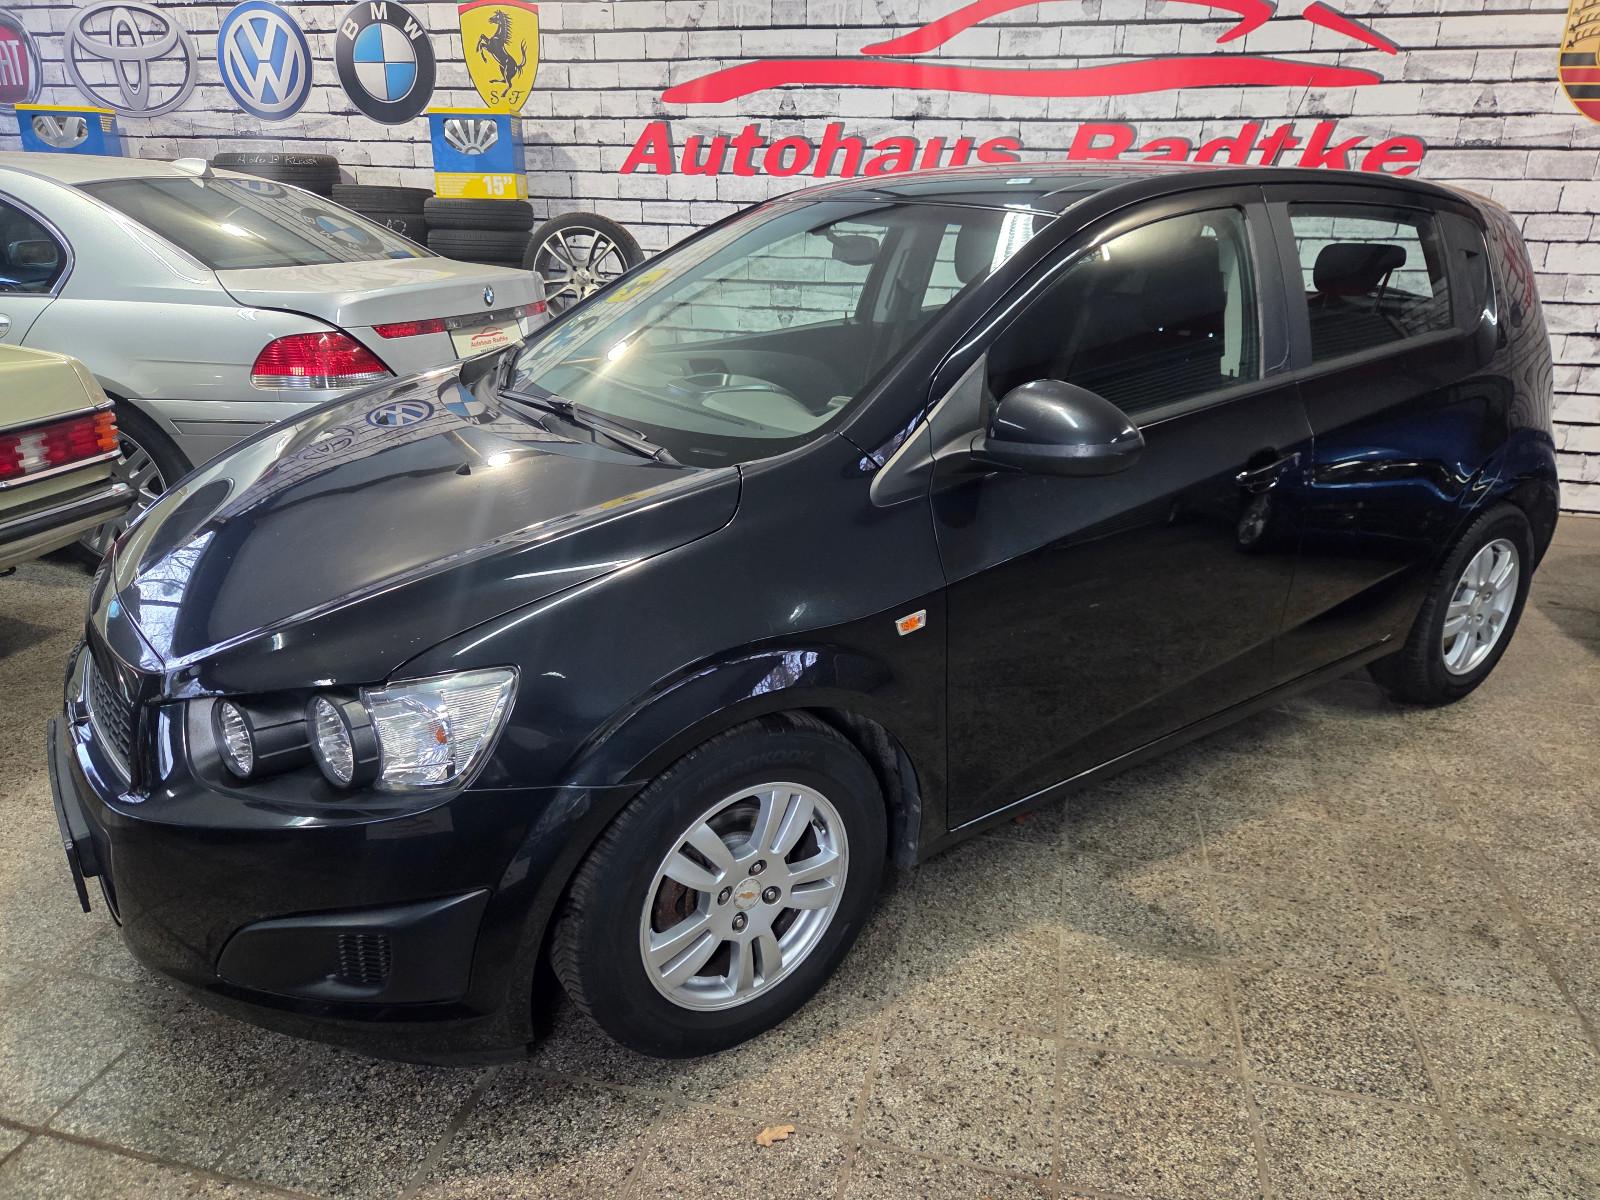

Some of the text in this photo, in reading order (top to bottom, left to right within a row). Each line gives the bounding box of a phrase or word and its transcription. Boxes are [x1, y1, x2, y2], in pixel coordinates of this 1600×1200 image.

[341, 2, 422, 41] BMW
[0, 39, 24, 86] AT
[618, 119, 1428, 179] Autohaus Radtke
